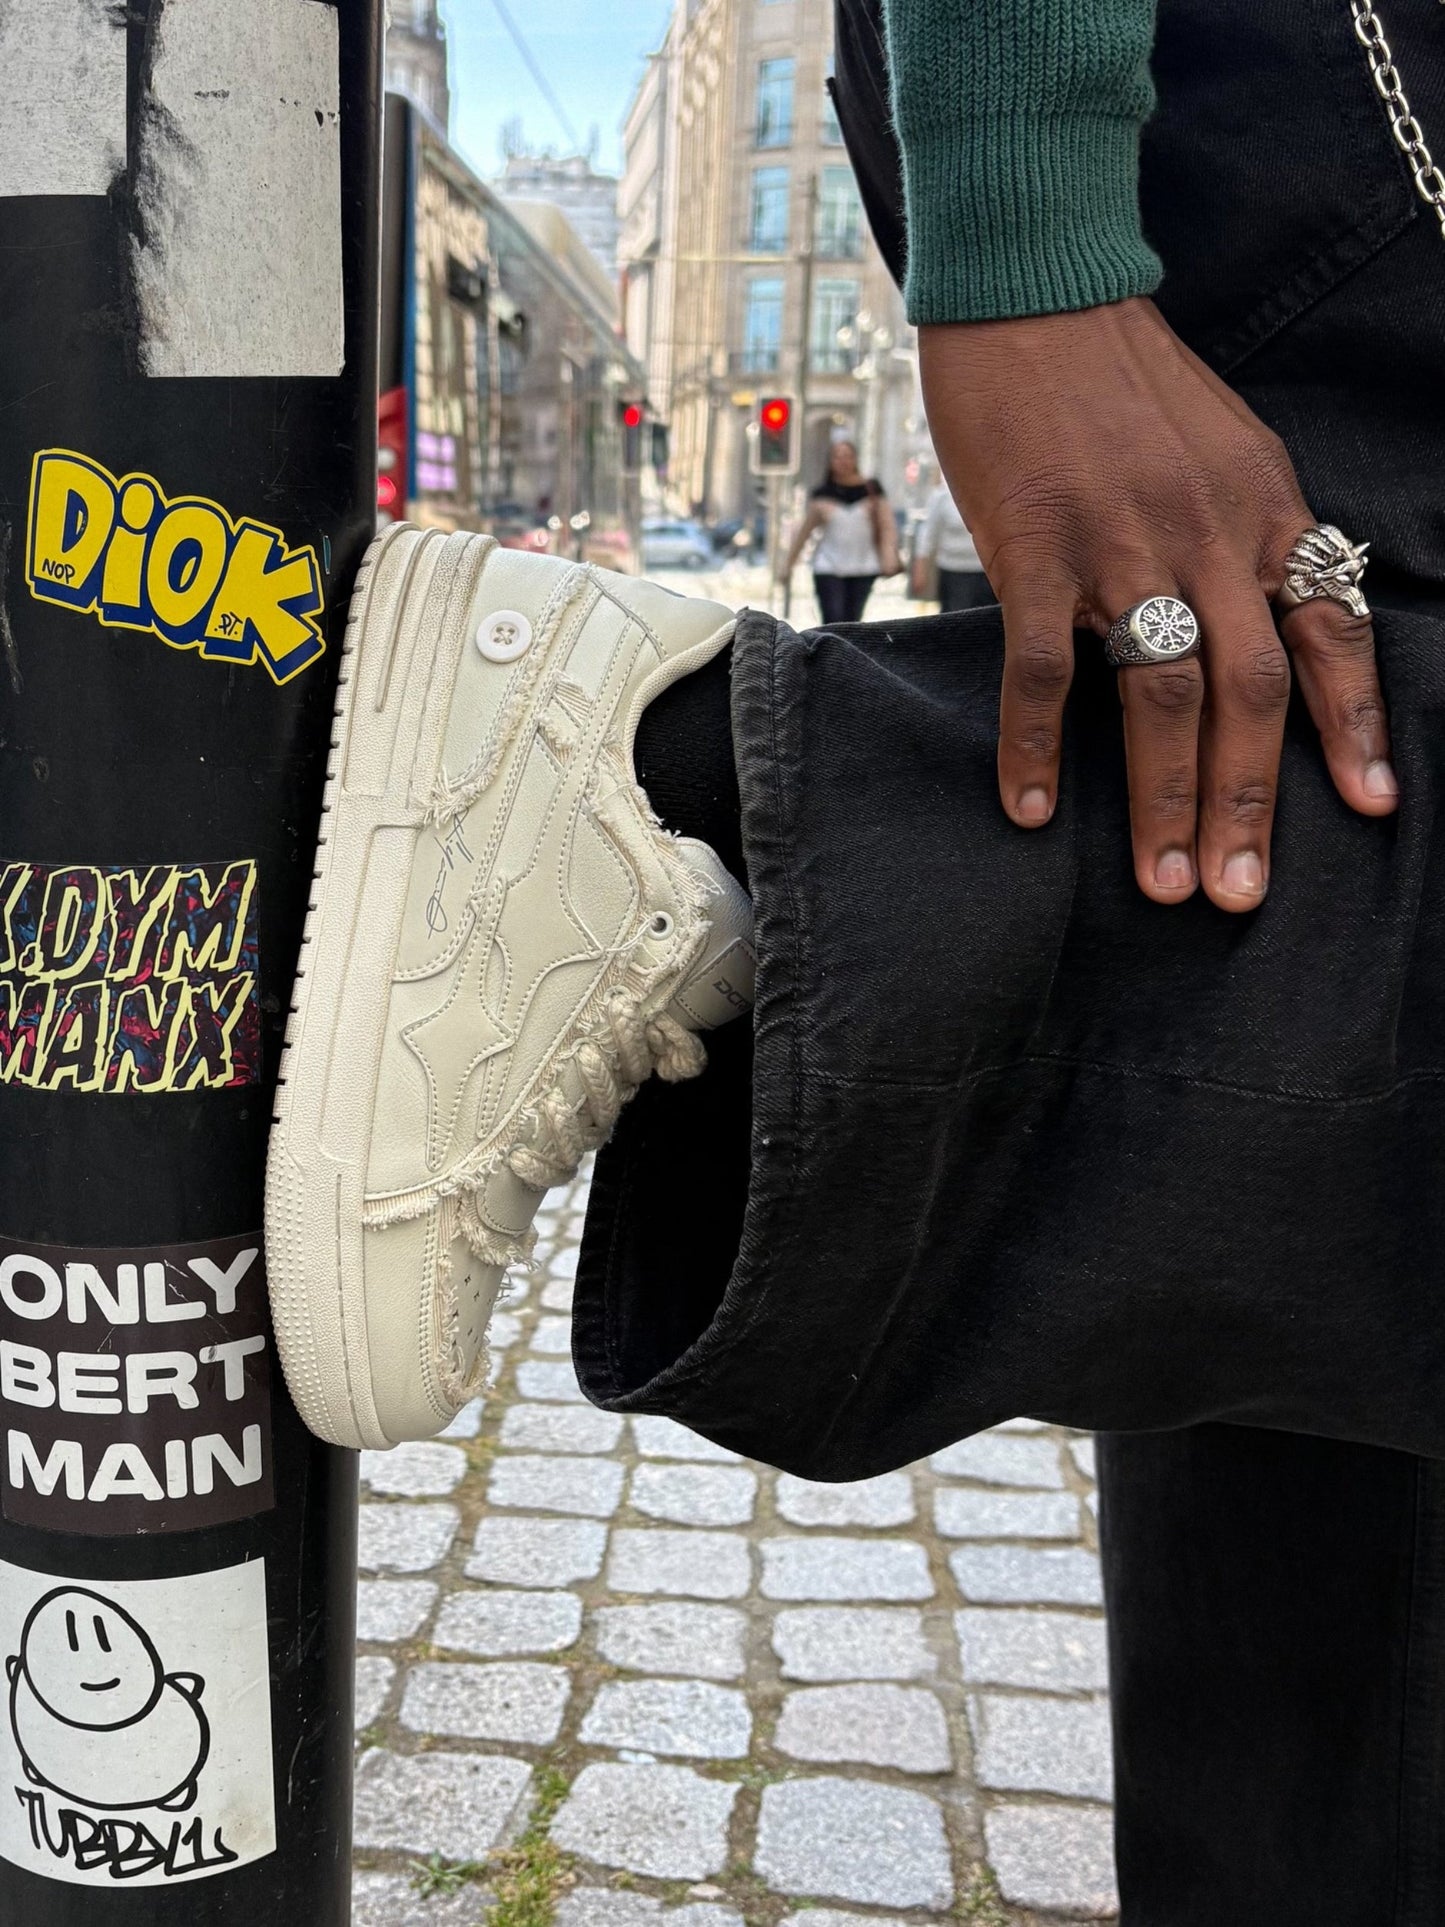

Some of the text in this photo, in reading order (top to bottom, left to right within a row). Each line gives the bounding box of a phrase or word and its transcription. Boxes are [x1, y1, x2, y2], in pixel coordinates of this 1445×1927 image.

[42, 558, 75, 584] NOP
[0, 1248, 259, 1325] ONLY
[0, 1335, 265, 1414] BERT
[8, 1424, 262, 1501] MAIN
